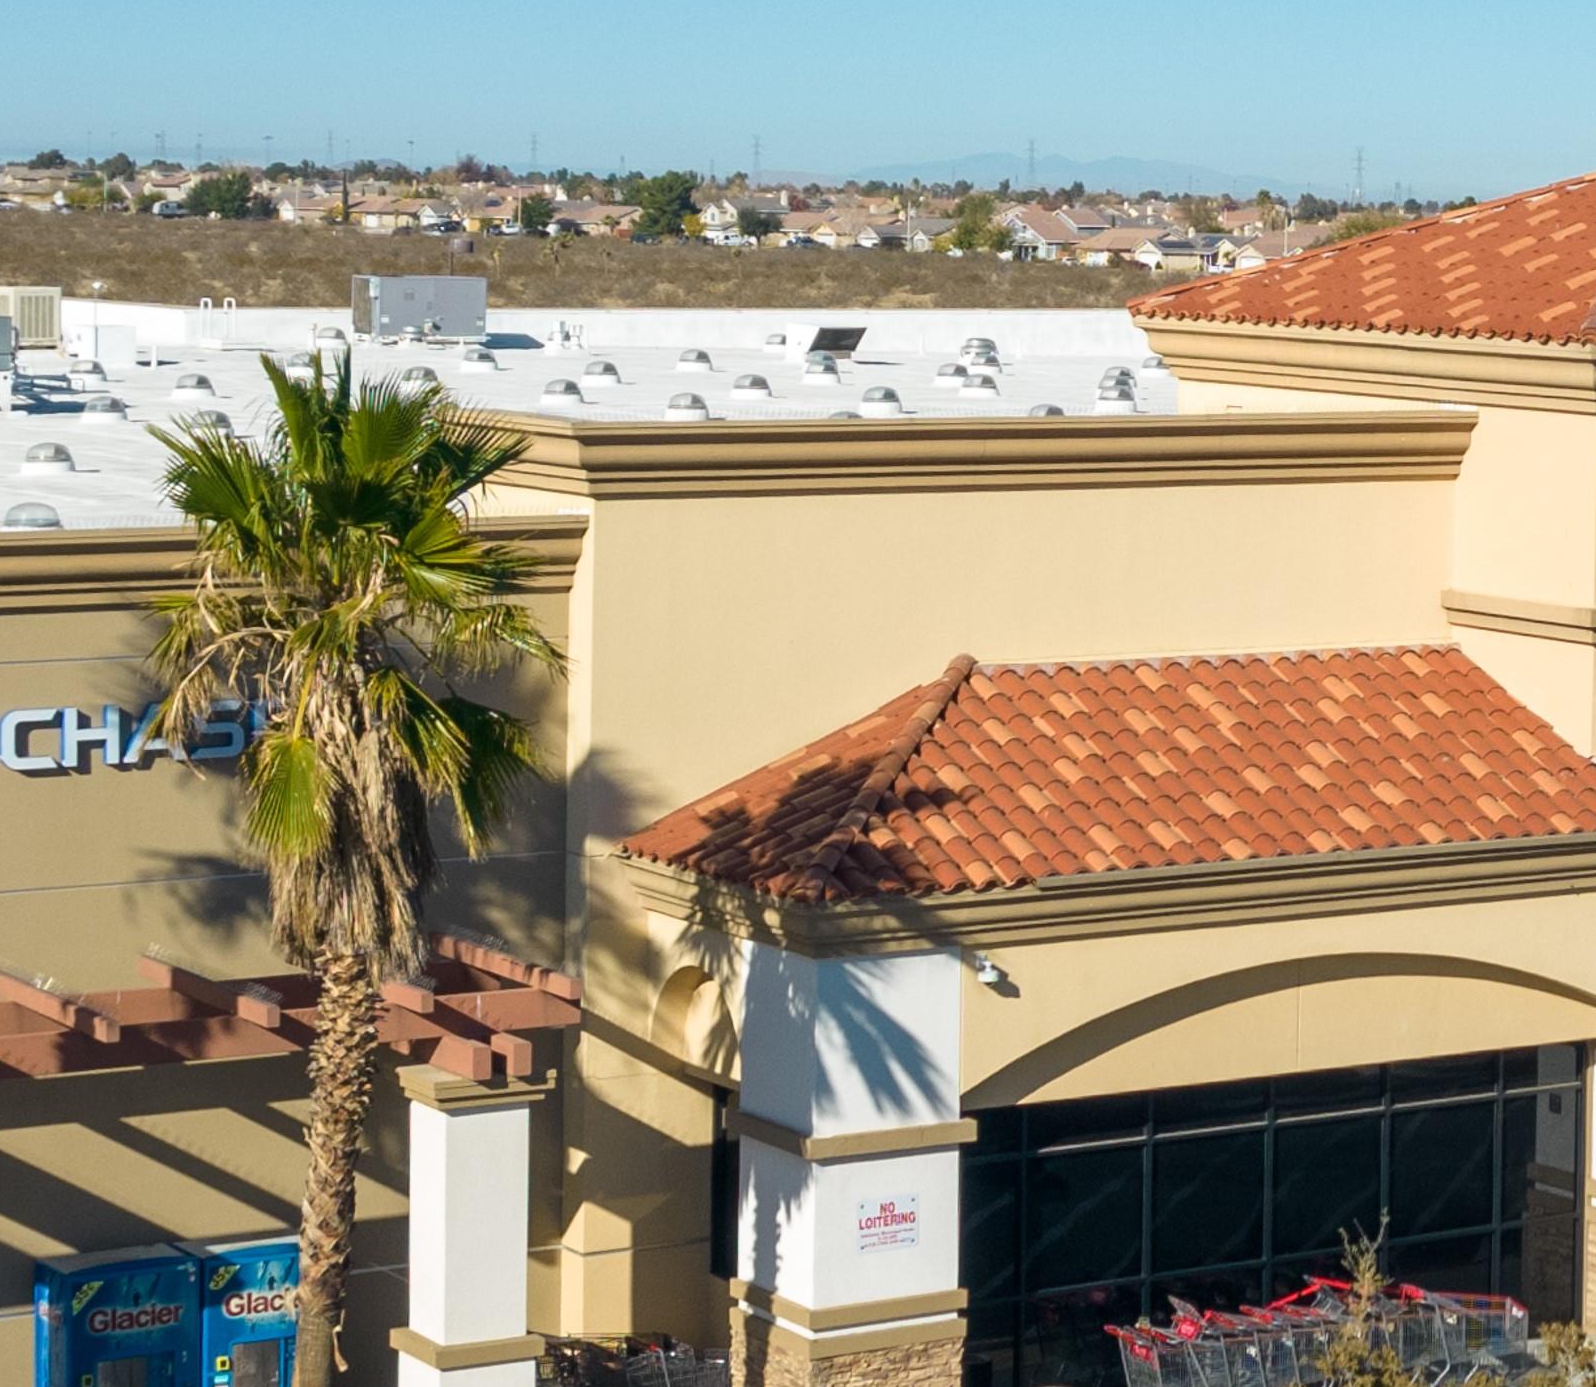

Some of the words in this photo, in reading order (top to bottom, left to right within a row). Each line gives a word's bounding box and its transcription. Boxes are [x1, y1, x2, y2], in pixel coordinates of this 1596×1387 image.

[879, 1201, 896, 1215] NO
[858, 1211, 916, 1231] LOITERING
[224, 1289, 294, 1317] Glac
[88, 1301, 183, 1334] Glacier
